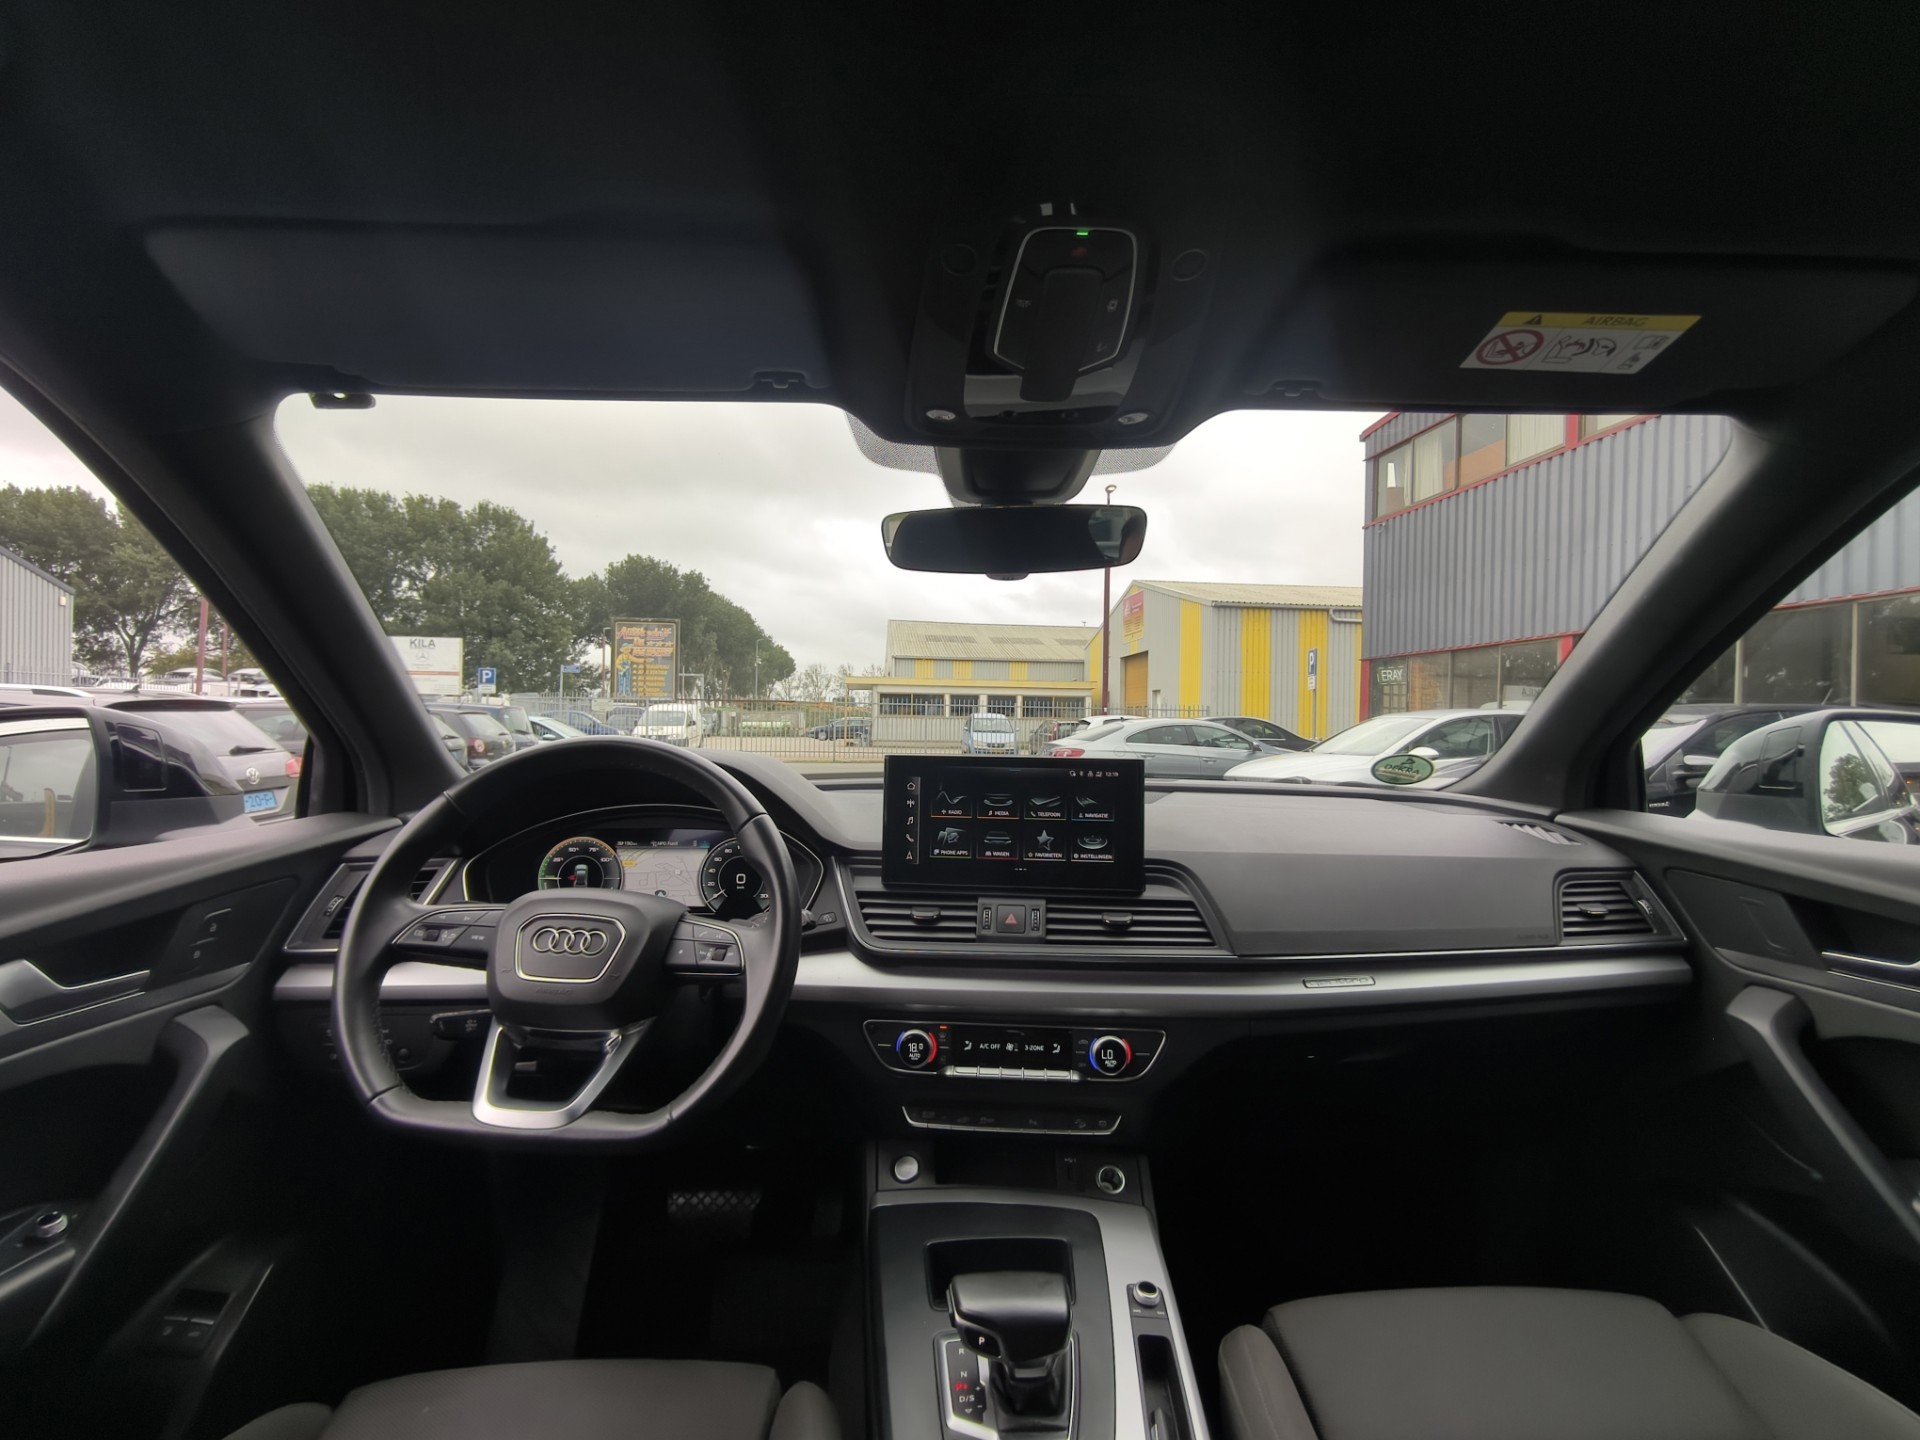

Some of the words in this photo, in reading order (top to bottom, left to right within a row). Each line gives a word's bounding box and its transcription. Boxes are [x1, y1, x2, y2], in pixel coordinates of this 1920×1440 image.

[1582, 316, 1648, 327] AIRBAG
[409, 638, 436, 649] KILA
[1309, 651, 1315, 673] P
[482, 670, 492, 683] P
[1381, 669, 1403, 681] ERAY
[1384, 763, 1419, 774] DEKRA
[1024, 1044, 1045, 1052] 3-ZONE
[978, 1336, 985, 1345] P
[959, 1395, 975, 1403] D/S
